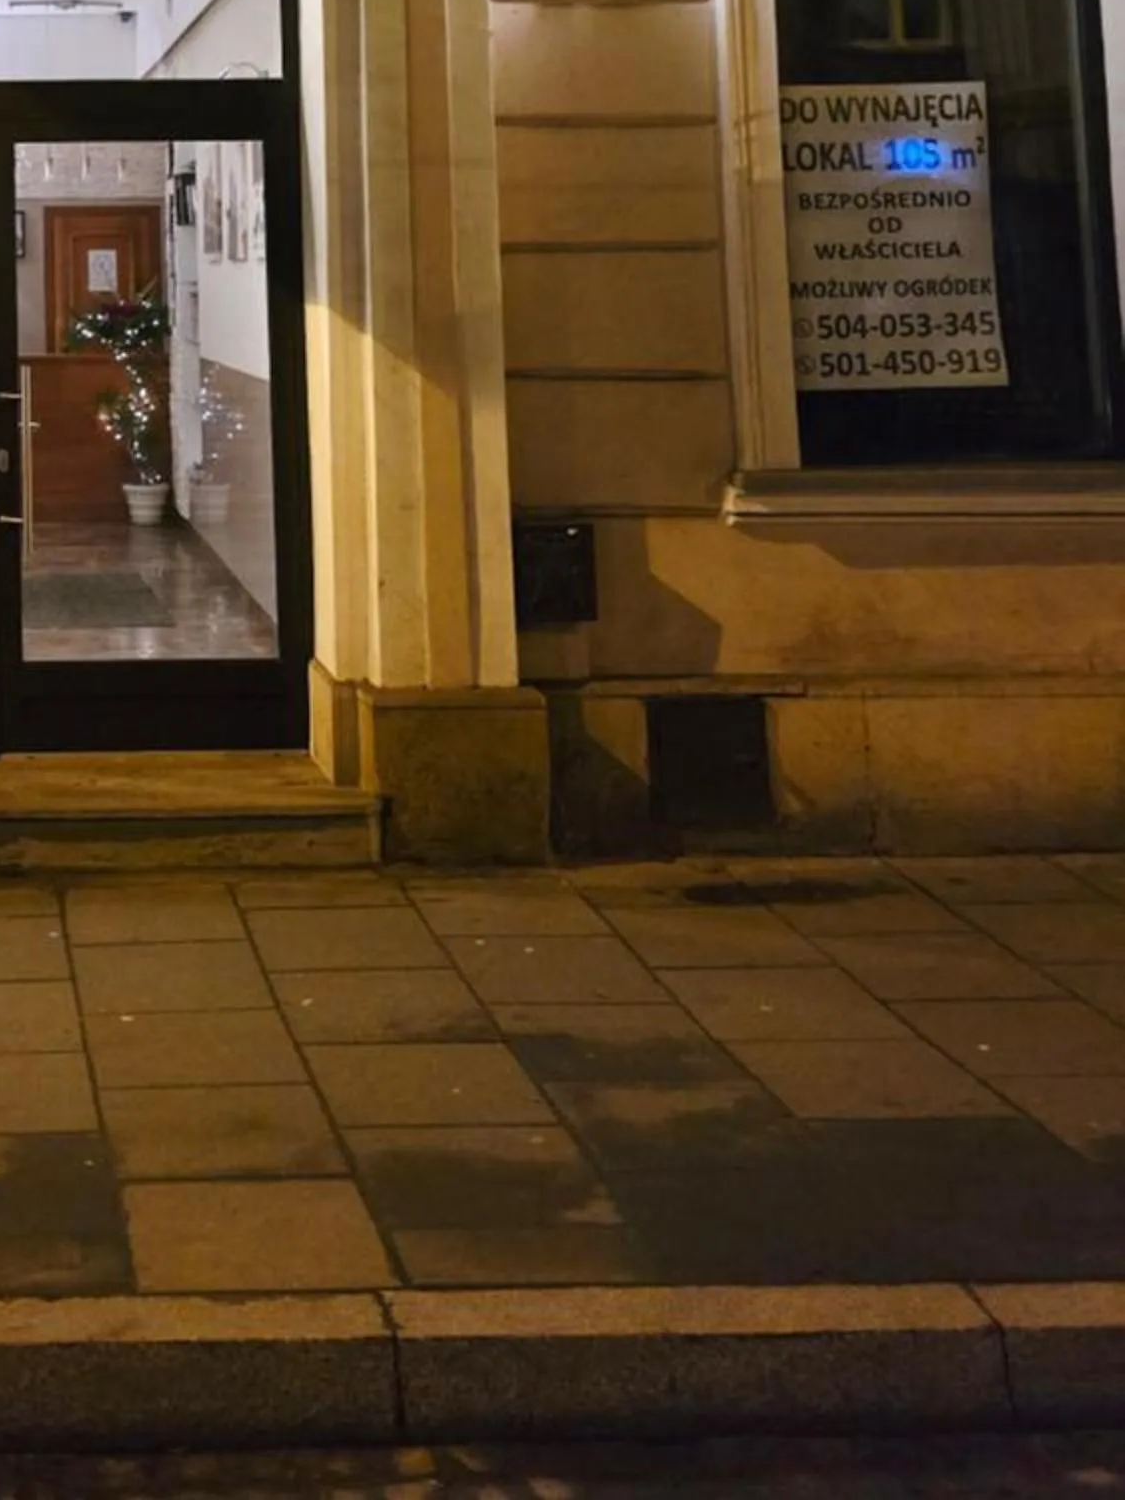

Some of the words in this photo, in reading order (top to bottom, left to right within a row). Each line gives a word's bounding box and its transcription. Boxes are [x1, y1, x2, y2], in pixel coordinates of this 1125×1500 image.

[779, 98, 818, 124] DO
[826, 94, 984, 128] WYNAJĘCIA
[782, 142, 873, 172] LOKAL
[885, 138, 941, 171] 105
[798, 189, 972, 211] BEZPOŚREDNIO
[867, 217, 903, 235] OD
[814, 240, 962, 261] WŁAŚCICIELA
[789, 279, 888, 300] MOŻLIWY
[893, 275, 993, 298] OGRÓDEK
[817, 311, 996, 340] 504-053-345
[820, 348, 1003, 378] 501-450-919
